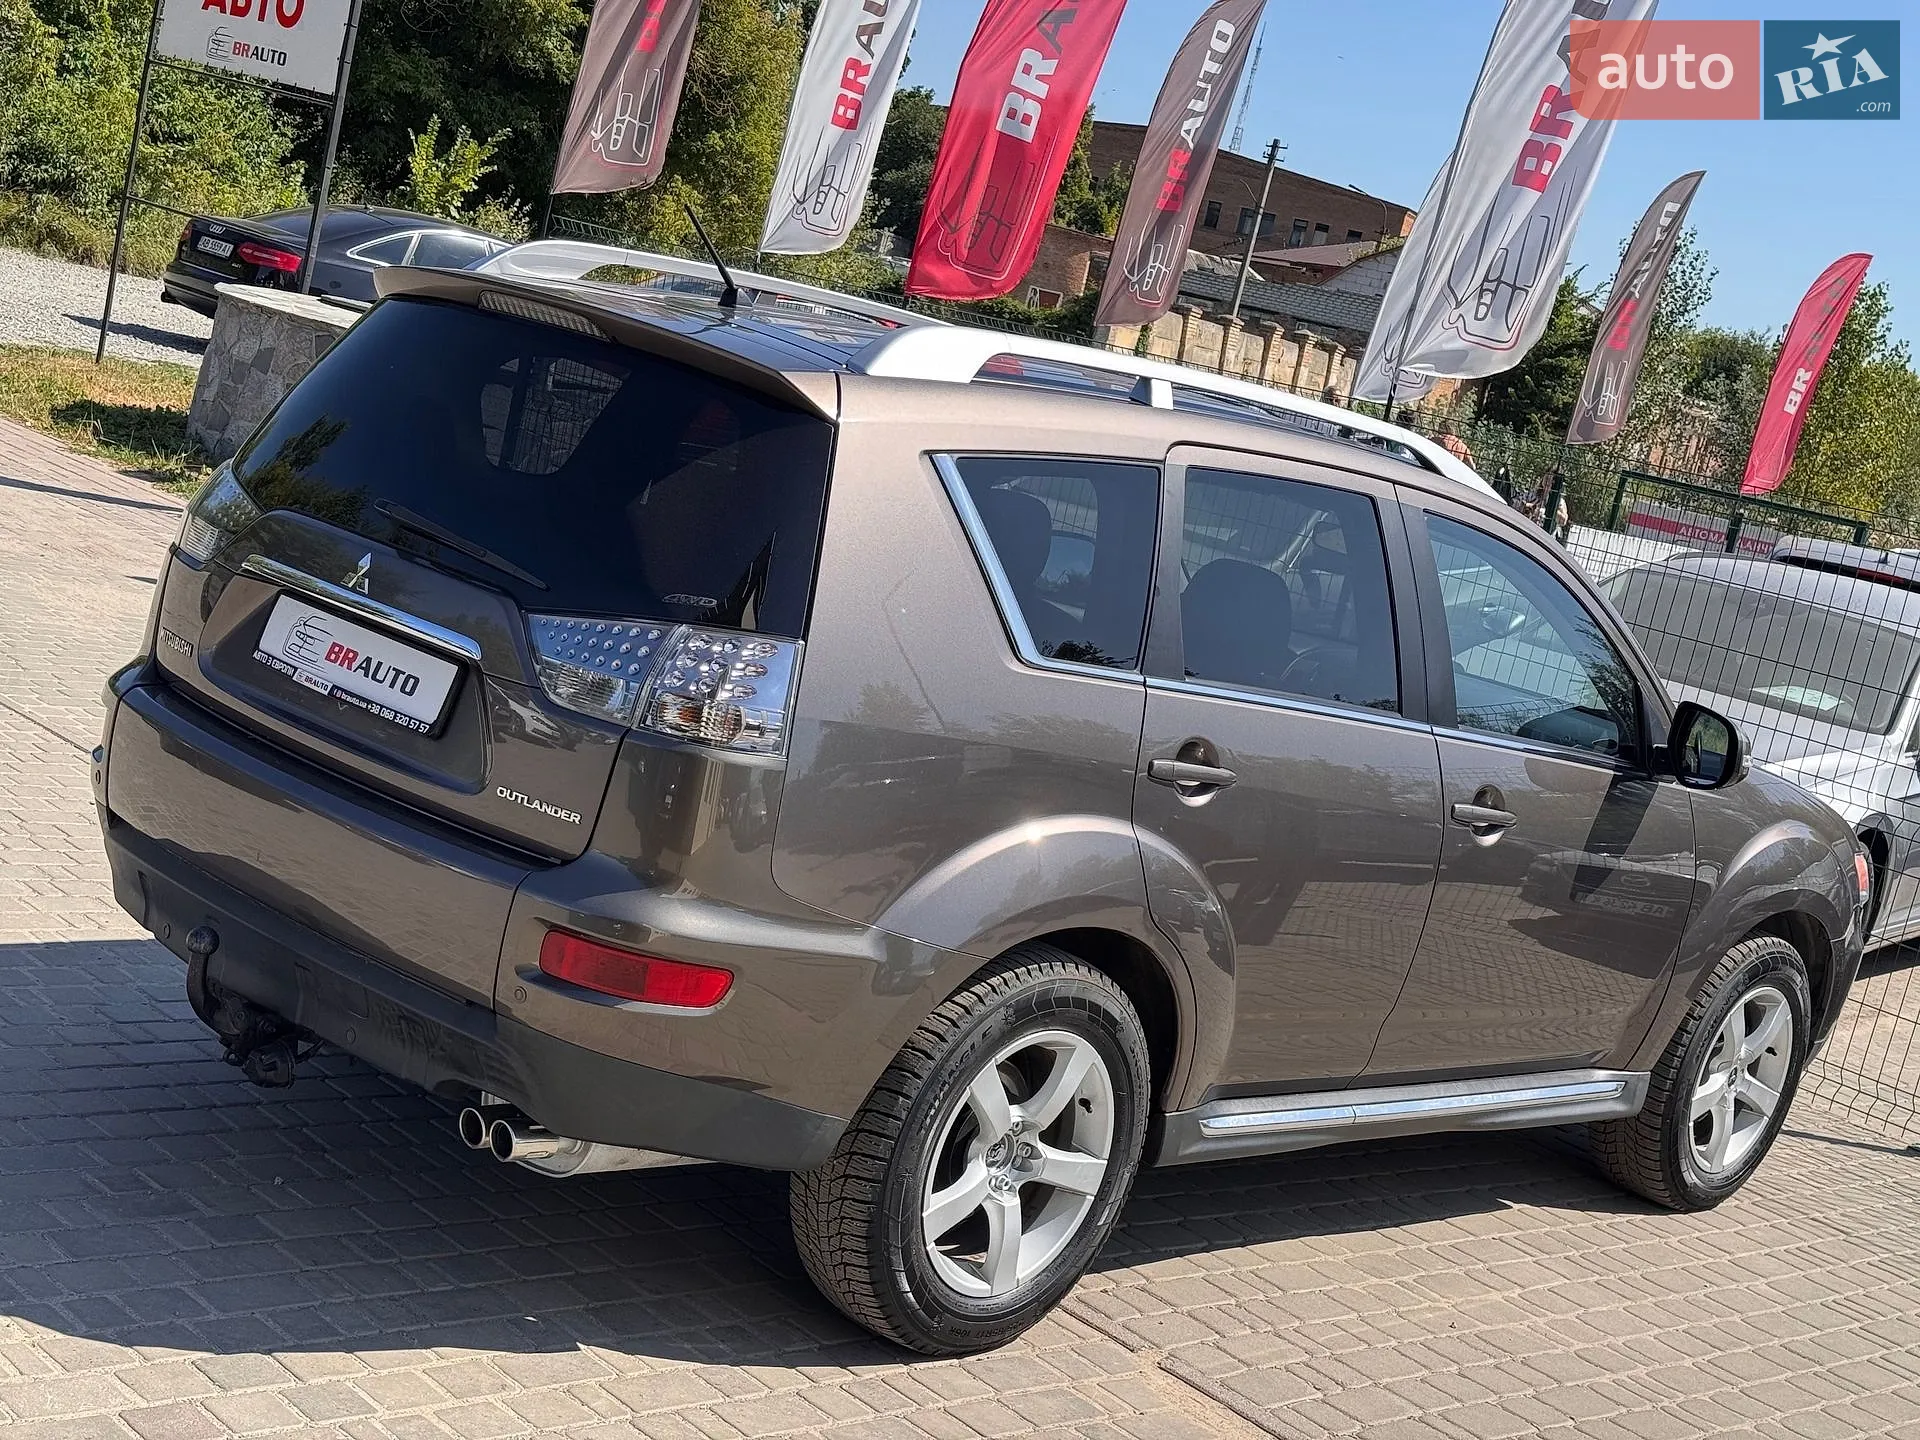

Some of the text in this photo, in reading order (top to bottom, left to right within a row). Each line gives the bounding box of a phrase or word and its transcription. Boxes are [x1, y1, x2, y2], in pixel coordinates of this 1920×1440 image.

[232, 41, 288, 67] BRAUTO
[995, 0, 1081, 143] BRA
[304, 675, 329, 691] BRAUTO
[324, 641, 421, 697] BRAUTO
[380, 708, 394, 721] 068
[394, 713, 408, 726] 320
[408, 718, 419, 730] 57
[418, 722, 430, 734] 57
[496, 786, 582, 825] OUTLANDER
